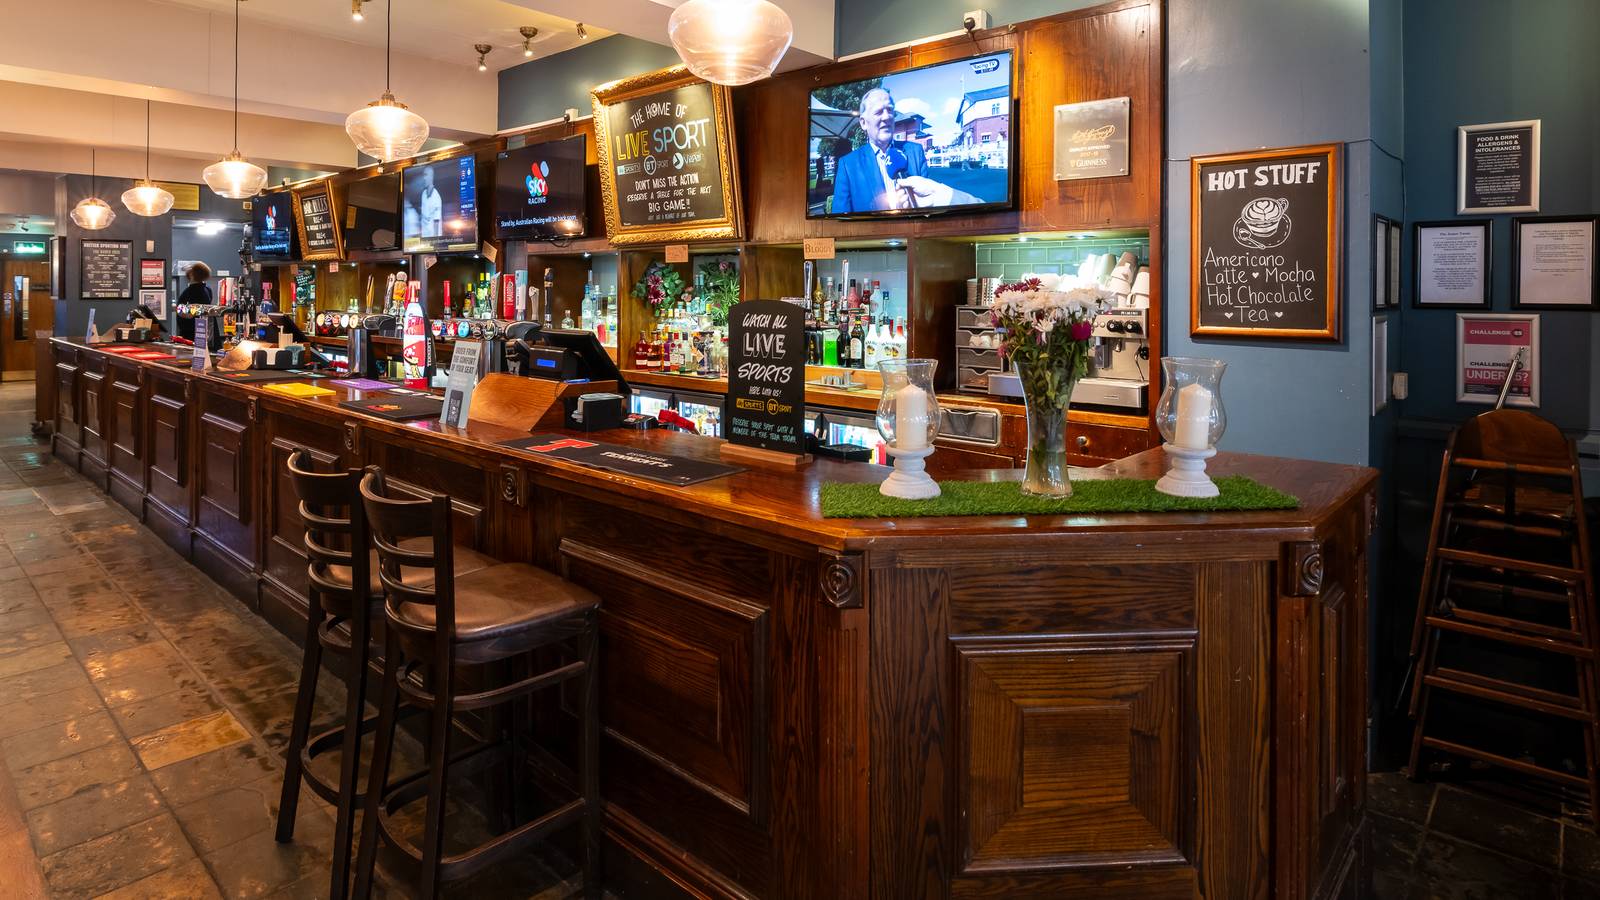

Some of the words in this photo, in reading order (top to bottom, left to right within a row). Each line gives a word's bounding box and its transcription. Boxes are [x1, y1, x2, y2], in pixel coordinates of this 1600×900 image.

[630, 108, 645, 128] THE
[645, 102, 671, 119] HOME
[676, 104, 688, 118] OF
[616, 130, 650, 160] LIVE
[653, 118, 710, 153] SPORT
[1476, 145, 1521, 153] INTOLERANCES
[645, 161, 655, 172] BT
[1076, 159, 1108, 168] GUINNESS
[635, 180, 650, 191] DON'T
[653, 178, 667, 189] MISS
[668, 176, 678, 187] THE
[680, 173, 700, 186] ACTION
[1208, 169, 1248, 192] HOT
[1255, 162, 1321, 186] STUFF
[674, 189, 685, 197] FOR
[687, 188, 697, 196] THE
[700, 186, 712, 194] NEXT
[528, 197, 546, 205] RACING
[648, 202, 661, 213] BIG
[533, 217, 545, 225] Racing
[1204, 247, 1285, 268] Americano
[1205, 268, 1248, 286] Latte
[1266, 261, 1316, 283] Mocha
[1208, 286, 1234, 306] Hot
[1237, 285, 1315, 305] Chocolate
[742, 313, 772, 328] WATCH
[772, 314, 788, 329] ALL
[1234, 306, 1270, 323] Tea
[466, 348, 477, 356] FROM
[743, 333, 786, 359] LIVE
[460, 356, 476, 365] COMFORT
[738, 363, 793, 384] SPORTS
[1467, 370, 1506, 380] UNDER
[768, 403, 777, 411] BT
